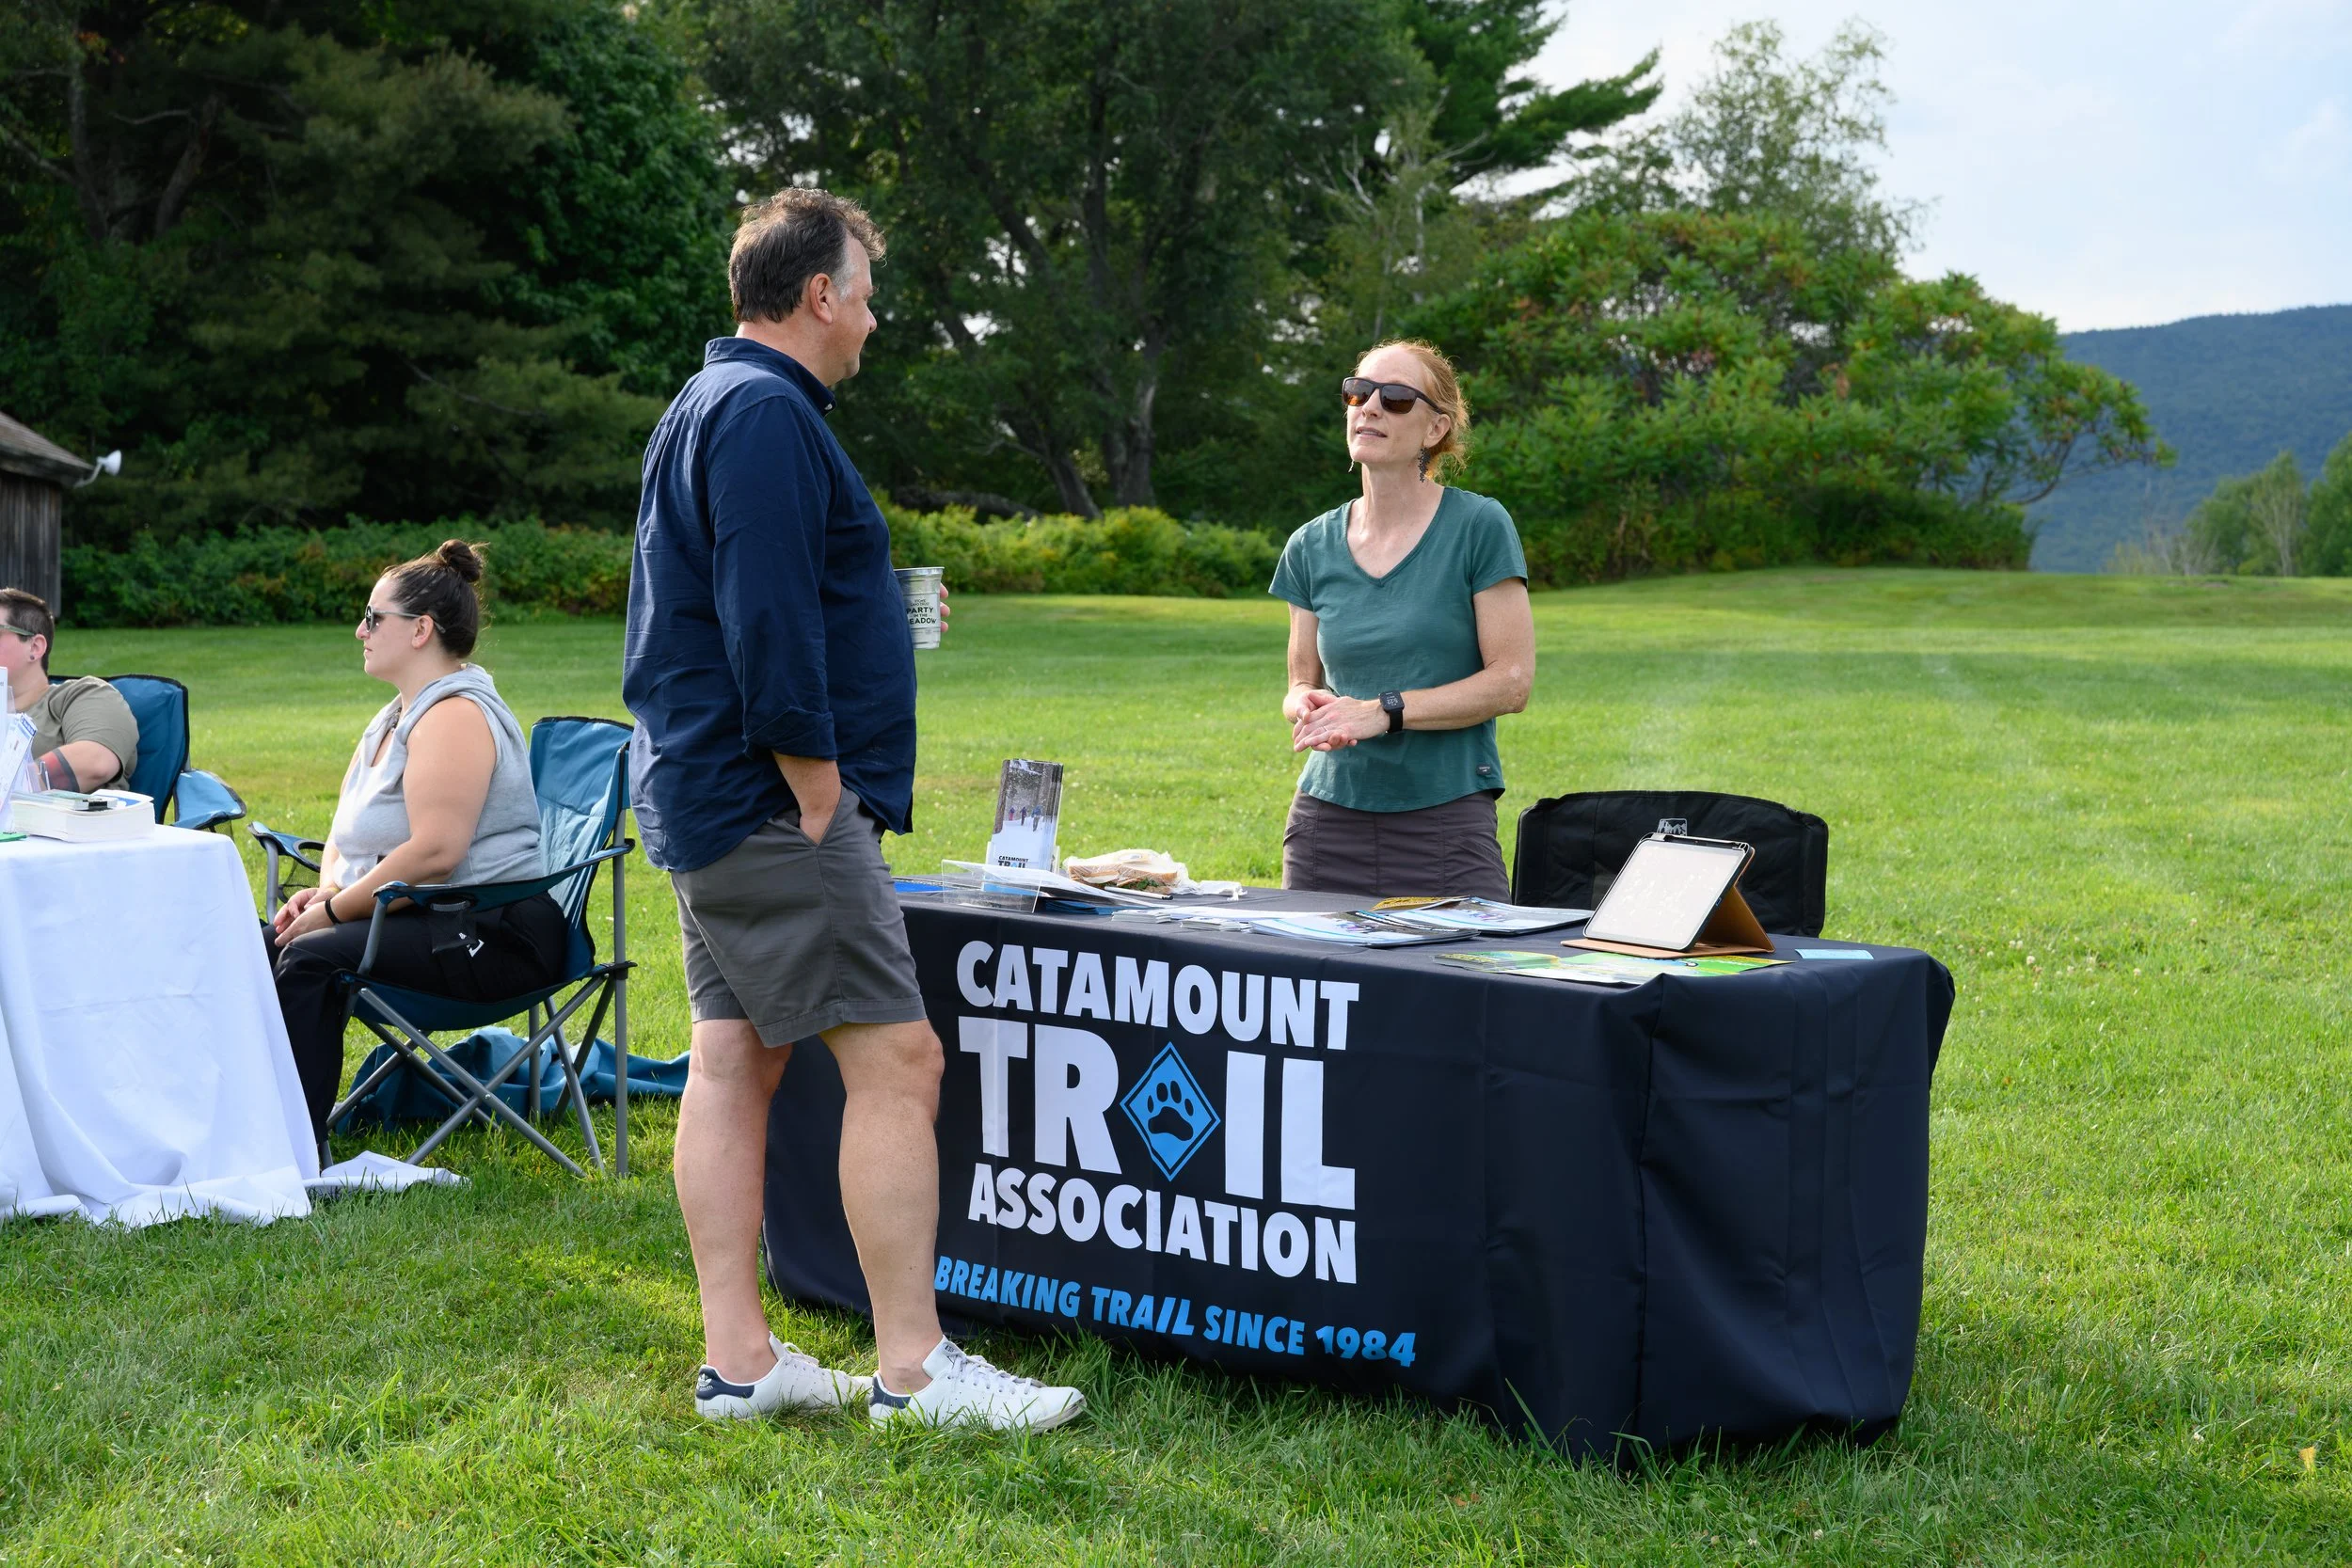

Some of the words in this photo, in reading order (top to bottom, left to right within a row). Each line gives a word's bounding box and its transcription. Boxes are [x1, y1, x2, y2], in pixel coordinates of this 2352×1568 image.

[957, 941, 1360, 1051] CATAMOUNT
[968, 1163, 1358, 1285] ASSOCIATION
[934, 1256, 1082, 1318] BREAKING
[1091, 1286, 1195, 1337] TRAIL
[1203, 1305, 1306, 1355] SINCE
[1316, 1325, 1417, 1369] 1984
